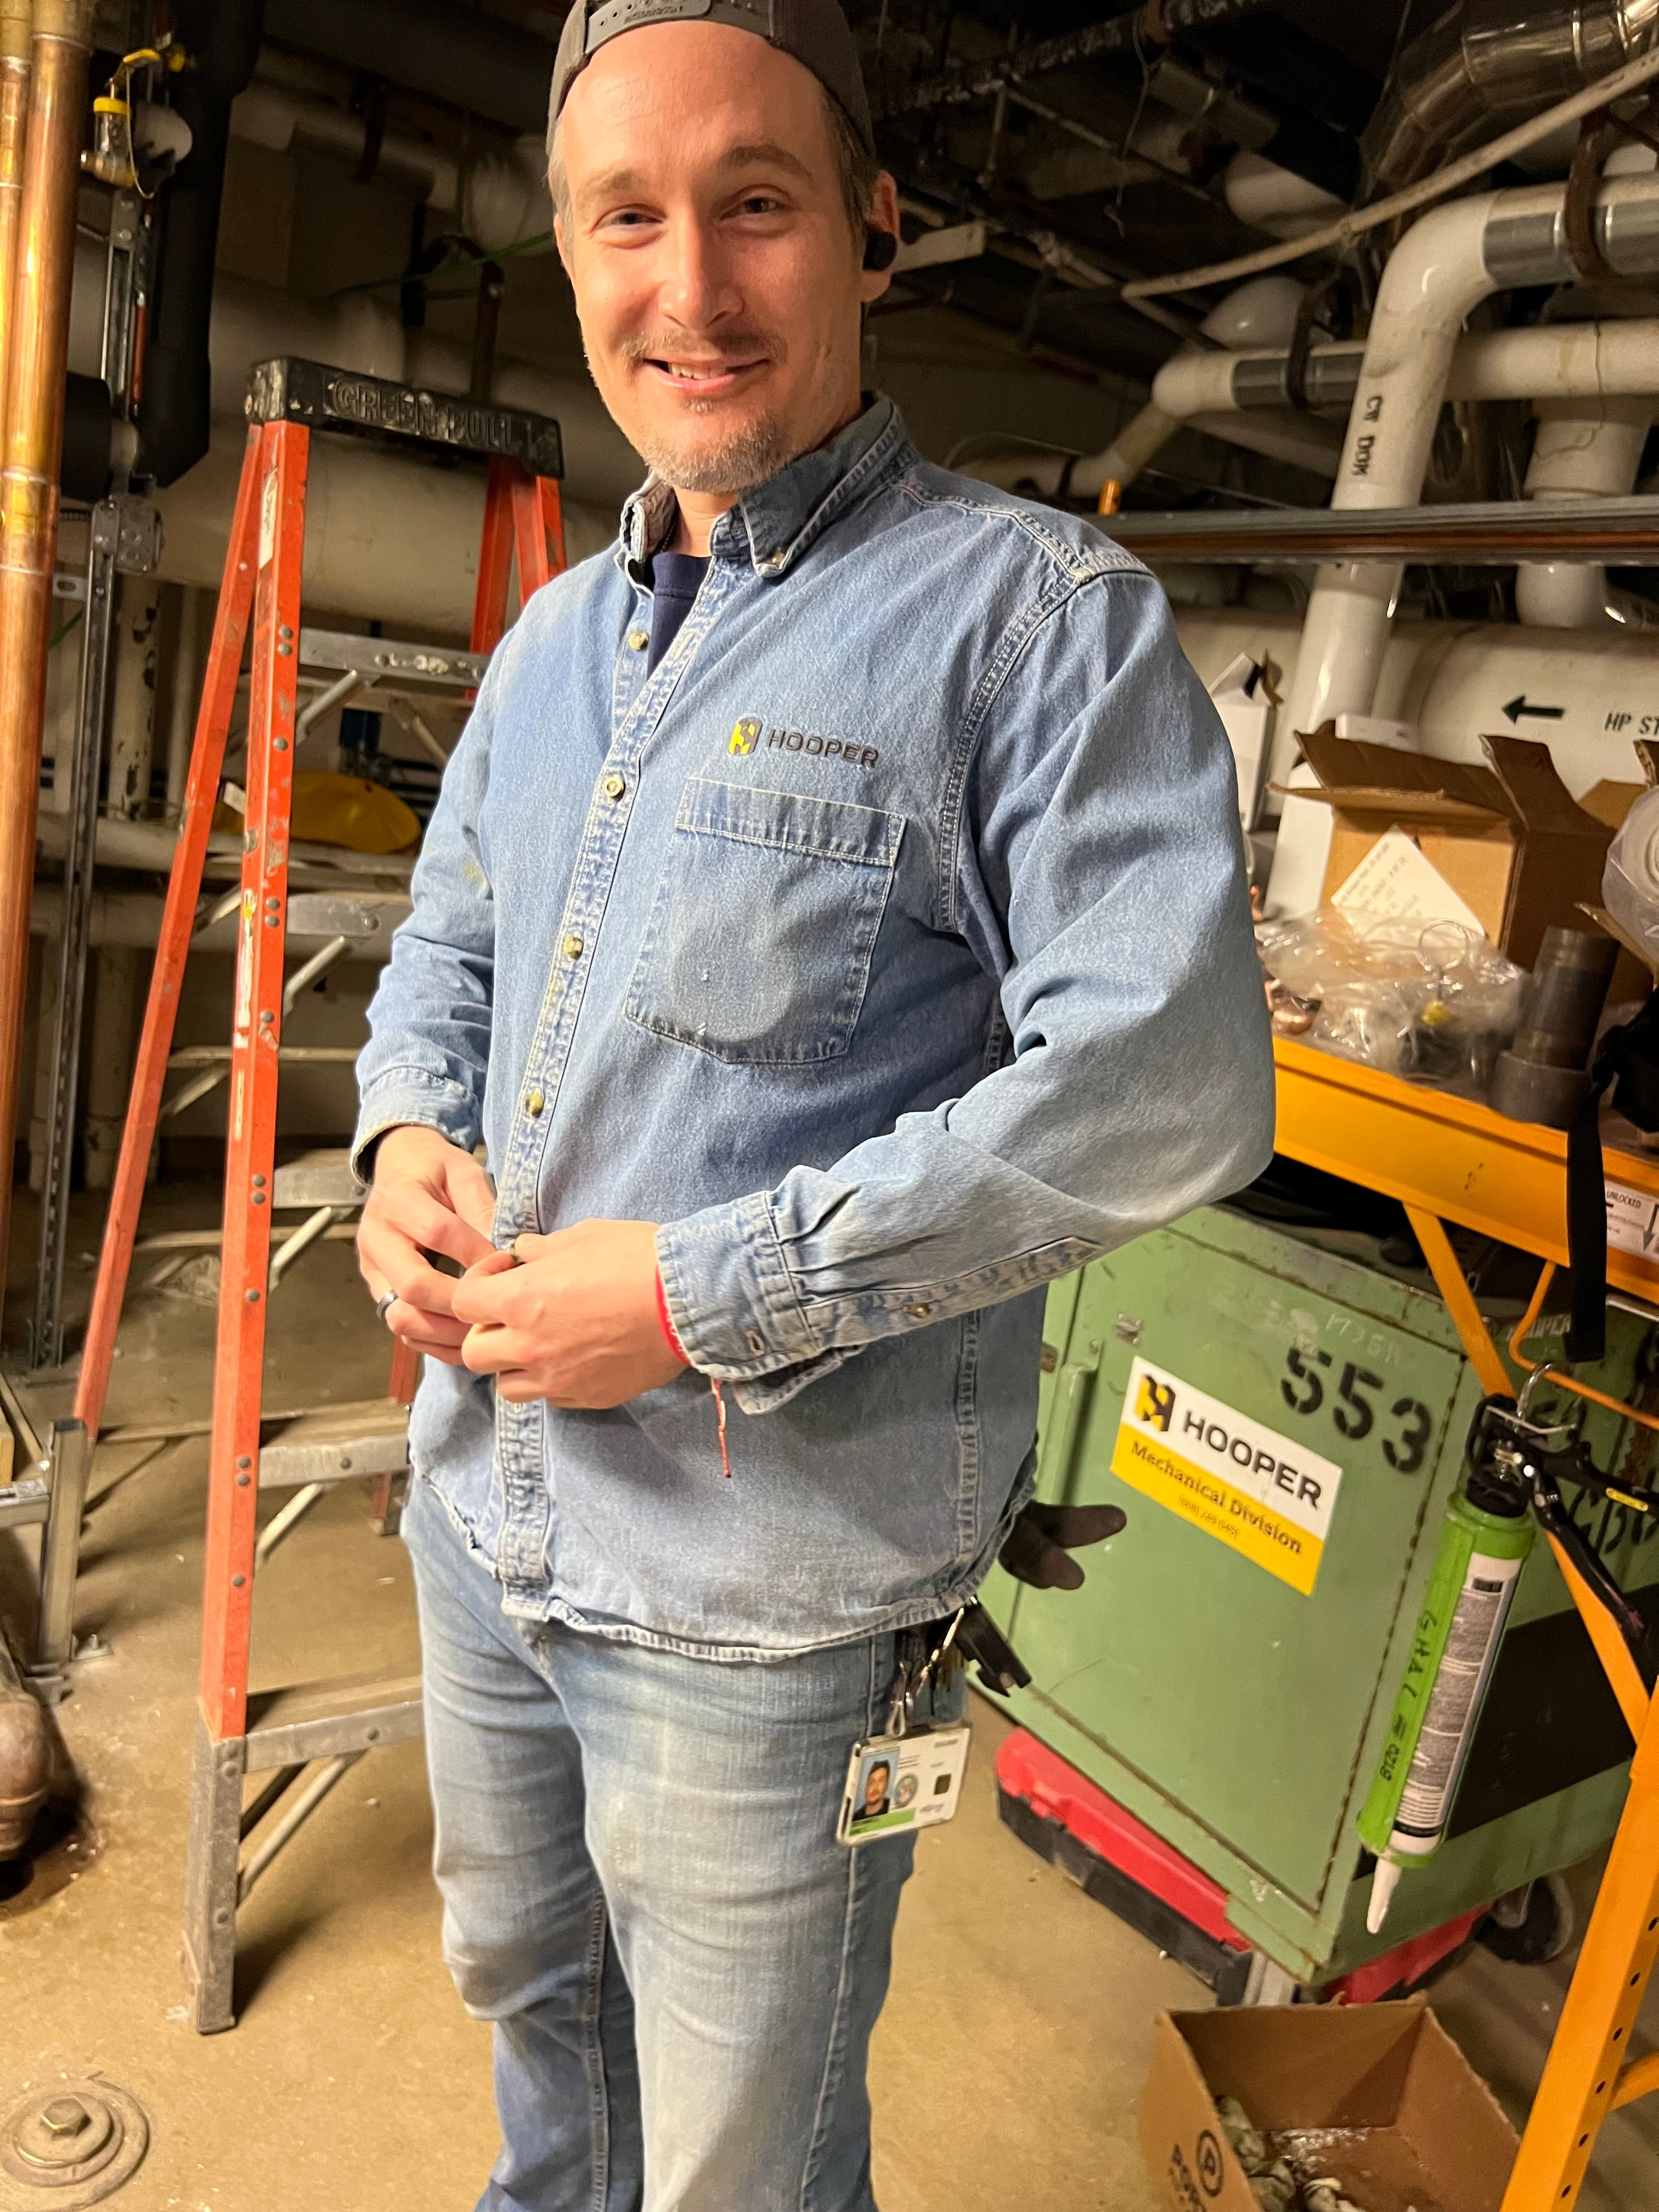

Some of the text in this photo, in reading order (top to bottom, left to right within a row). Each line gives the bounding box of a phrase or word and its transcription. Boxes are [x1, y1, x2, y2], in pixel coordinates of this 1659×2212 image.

[332, 381, 437, 436] GREEN
[1351, 435, 1375, 476] DOM
[1604, 713, 1632, 731] HP
[767, 729, 879, 769] HOOPER
[1606, 1190, 1641, 1208] UNLOCKED
[1280, 1347, 1431, 1474] 553
[1183, 1409, 1322, 1511] HOOPER
[1131, 1439, 1228, 1508] Mechanical
[1229, 1498, 1302, 1554] Division
